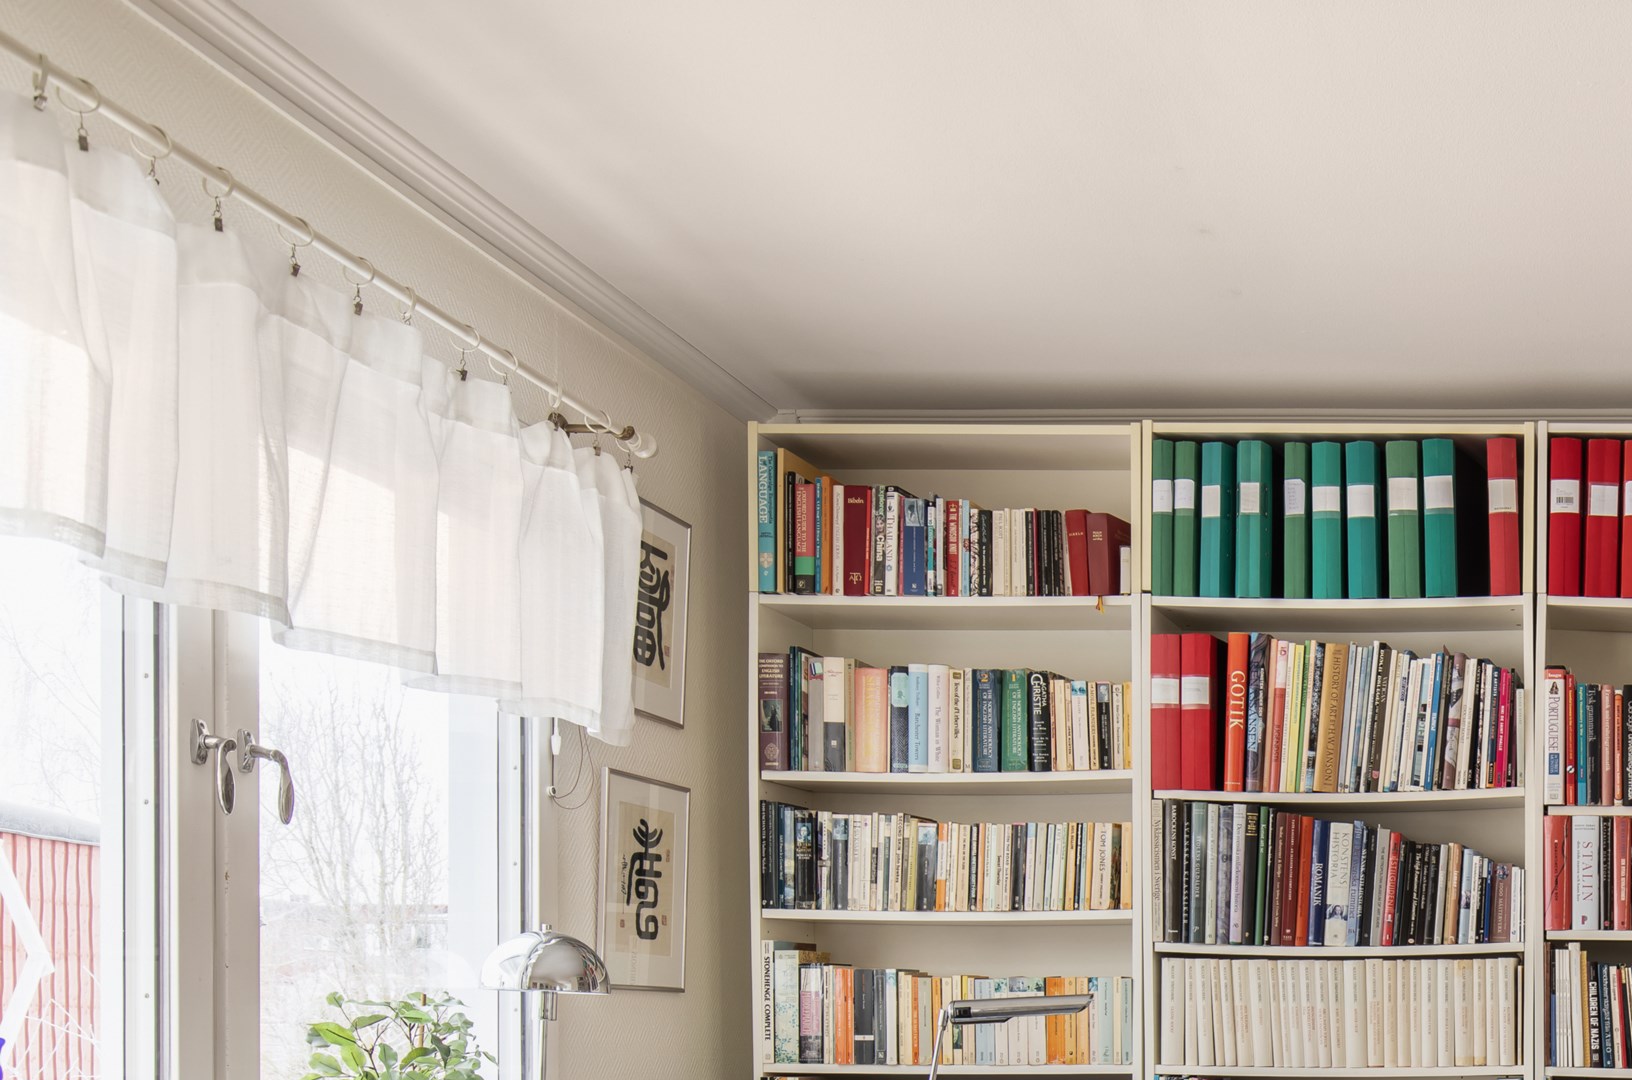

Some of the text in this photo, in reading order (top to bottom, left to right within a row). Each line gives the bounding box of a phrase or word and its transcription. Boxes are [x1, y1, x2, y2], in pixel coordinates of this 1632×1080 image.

[759, 456, 768, 523] LANGUAGE
[876, 535, 885, 562] China
[886, 515, 895, 561] THAILAND
[1032, 674, 1043, 715] CHRISTIE
[1330, 657, 1340, 690] HISTORY
[1229, 671, 1245, 729] GOTIK
[1330, 692, 1339, 702] OF
[1587, 689, 1596, 742] Tysk grammatik
[1548, 697, 1560, 751] PORTUGUESE
[1325, 747, 1334, 780] JANSON
[1099, 831, 1107, 871] TOM JONES
[1153, 819, 1161, 870] Nyklassicismen
[1330, 832, 1340, 878] HISTORIA
[1339, 832, 1350, 885] KONSTENS
[1153, 876, 1161, 900] Sverige
[1313, 863, 1323, 906] ROMANIK
[1388, 860, 1397, 906] STILGUIDEN
[1582, 841, 1593, 901] STALIN
[1589, 982, 1599, 1049] CHILDREN OF NAZIS
